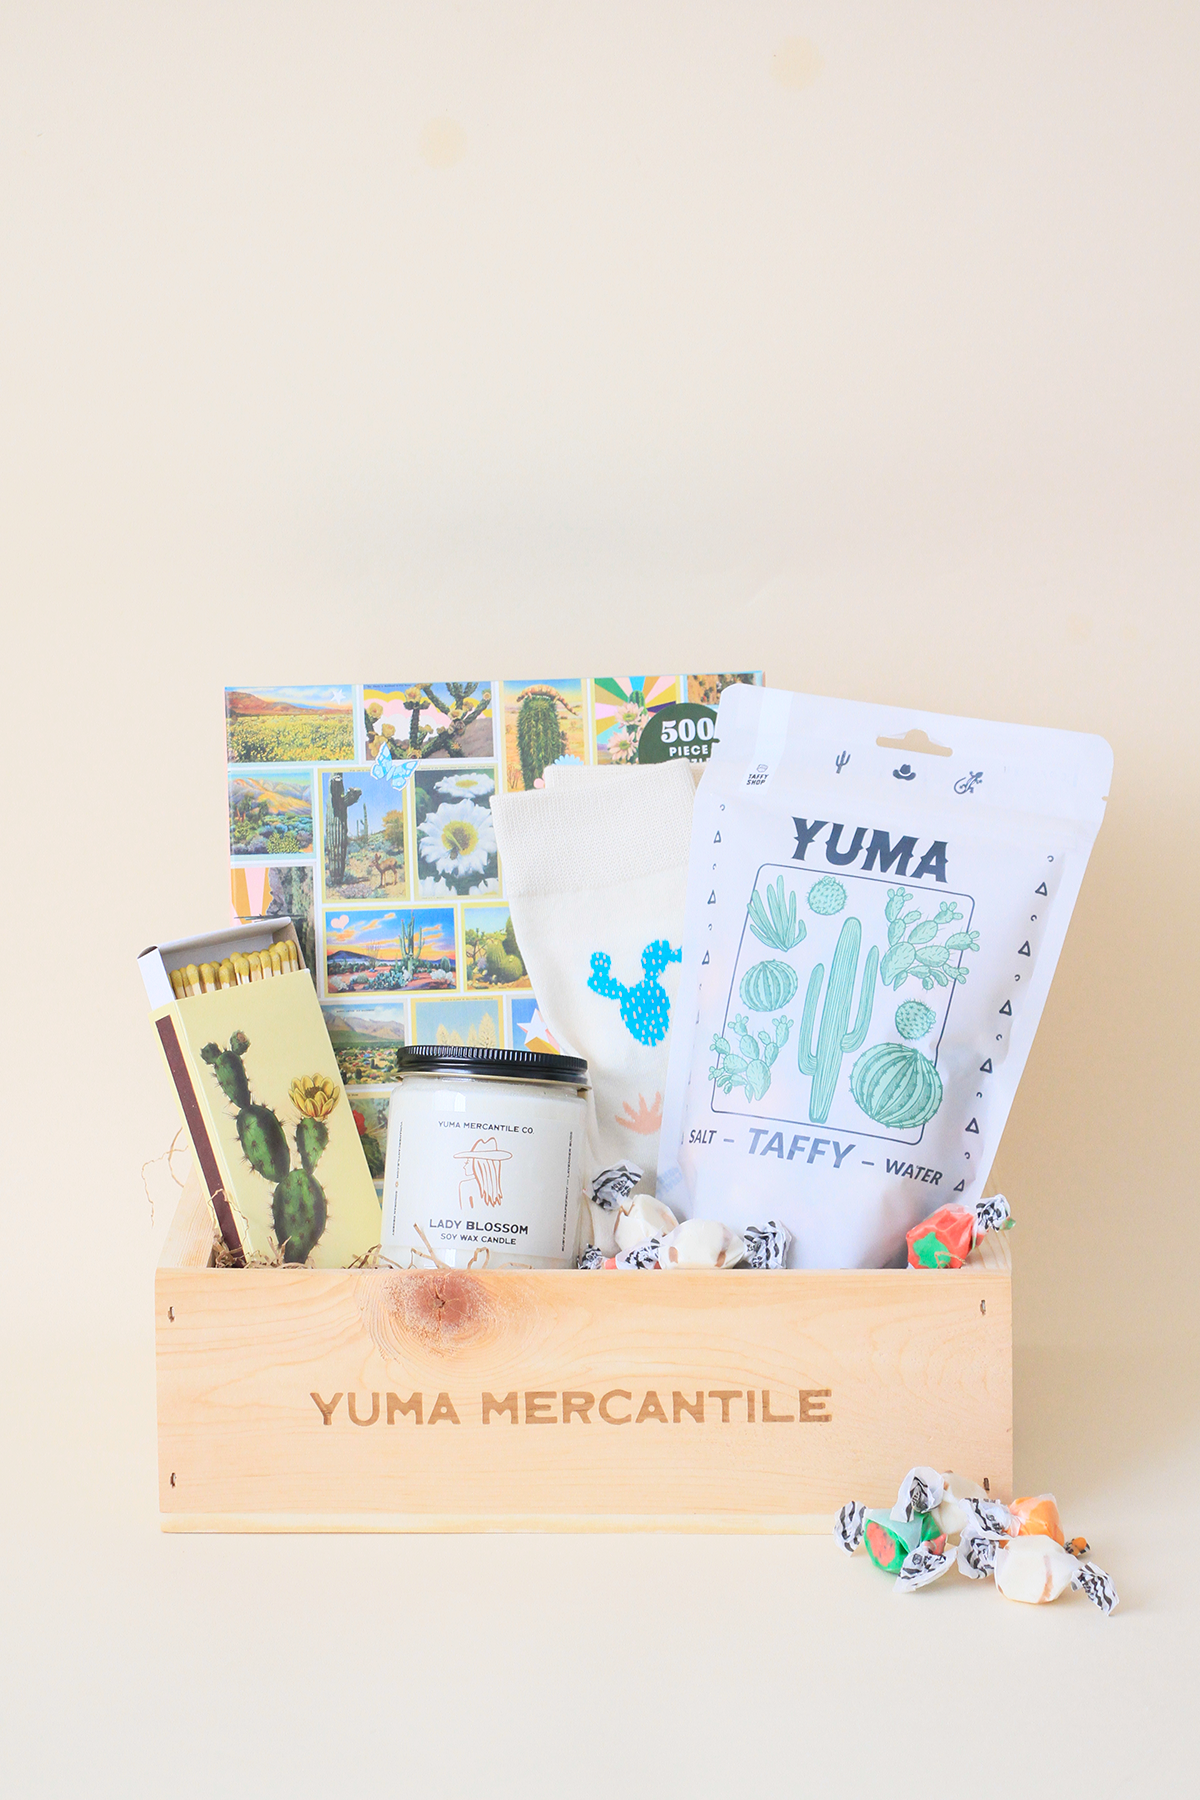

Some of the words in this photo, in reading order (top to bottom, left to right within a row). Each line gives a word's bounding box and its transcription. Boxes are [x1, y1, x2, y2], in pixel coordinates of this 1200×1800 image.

[660, 717, 715, 743] 500
[669, 744, 709, 757] PIECE
[791, 816, 949, 883] YUMA
[438, 1120, 461, 1128] YUMA
[463, 1122, 520, 1133] MERCANTILE
[521, 1126, 535, 1135] CO.
[688, 1129, 717, 1145] SALT
[748, 1127, 856, 1169] TAFFY
[885, 1158, 944, 1186] WATER
[429, 1219, 461, 1229] LADY
[466, 1221, 529, 1235] BLOSSOM
[460, 1234, 478, 1242] WAX
[480, 1236, 517, 1245] CANDLE
[310, 1391, 461, 1426] YUMA
[482, 1388, 832, 1426] MERCANTILE
